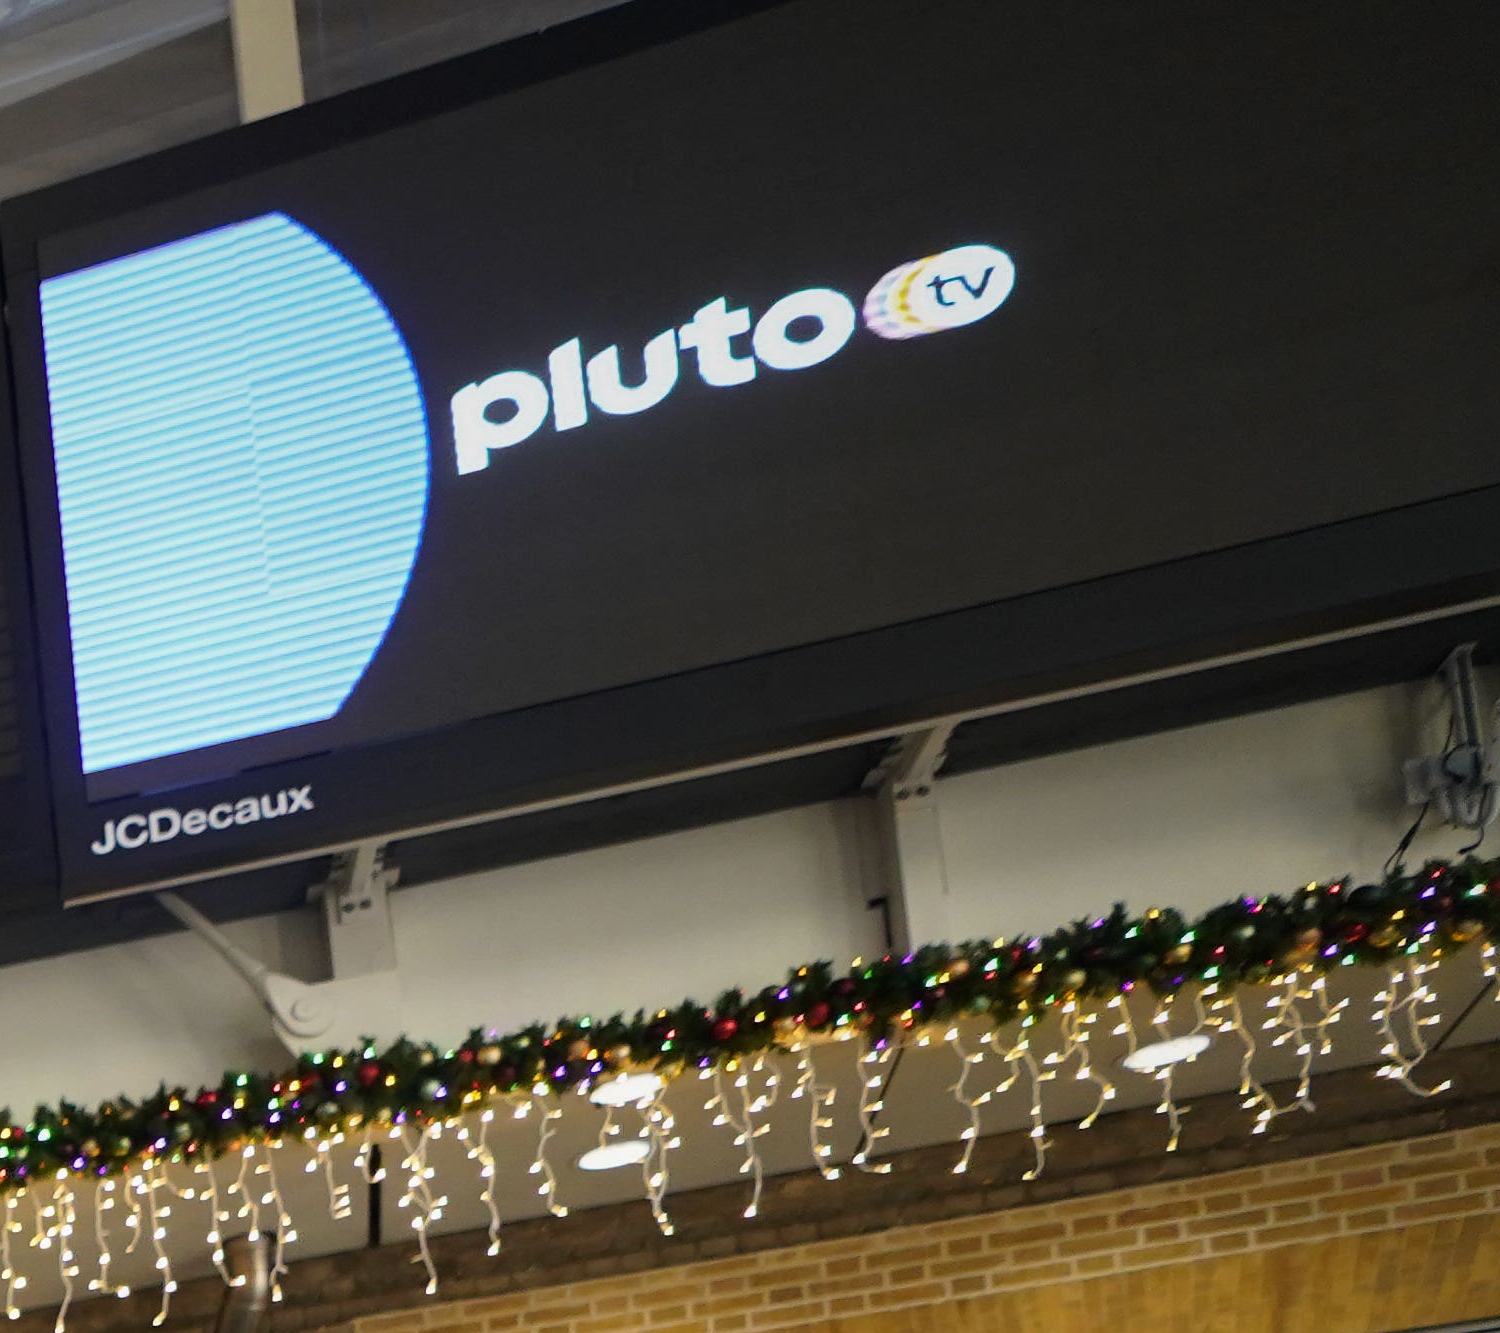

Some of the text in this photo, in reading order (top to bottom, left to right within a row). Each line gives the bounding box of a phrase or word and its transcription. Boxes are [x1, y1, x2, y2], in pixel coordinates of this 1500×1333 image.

[451, 266, 996, 475] pluto tv
[91, 785, 315, 855] JCDecaux
